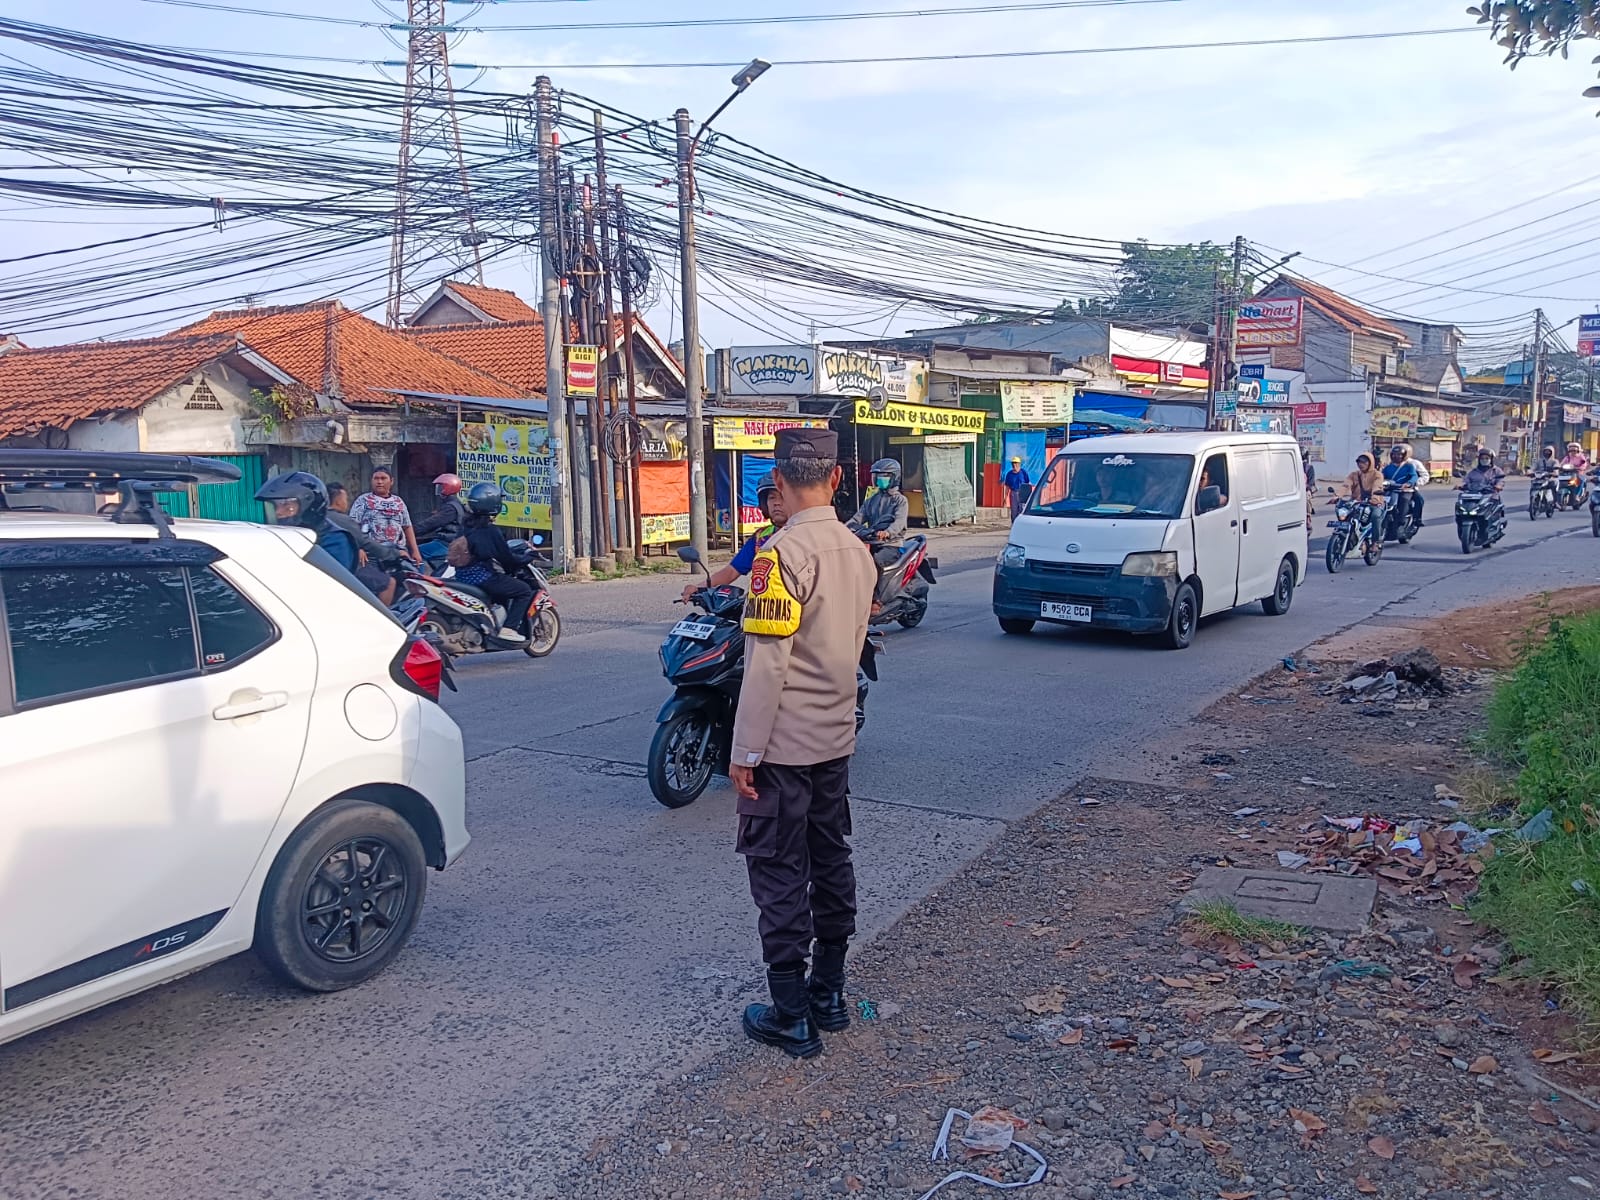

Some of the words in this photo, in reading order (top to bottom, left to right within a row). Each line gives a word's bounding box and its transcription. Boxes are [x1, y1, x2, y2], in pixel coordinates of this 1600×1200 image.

[575, 353, 591, 361] GIGI
[737, 354, 809, 377] NAKHLA
[750, 369, 796, 385] SABLON
[858, 405, 905, 422] SABLON
[908, 410, 917, 423] &
[920, 411, 949, 425] KAOS
[951, 414, 982, 428] POLOS
[744, 421, 766, 435] NASI
[459, 453, 508, 464] WARUNG
[458, 462, 496, 472] KETOPRAK
[1042, 602, 1048, 612] B
[135, 930, 188, 958] ADS
